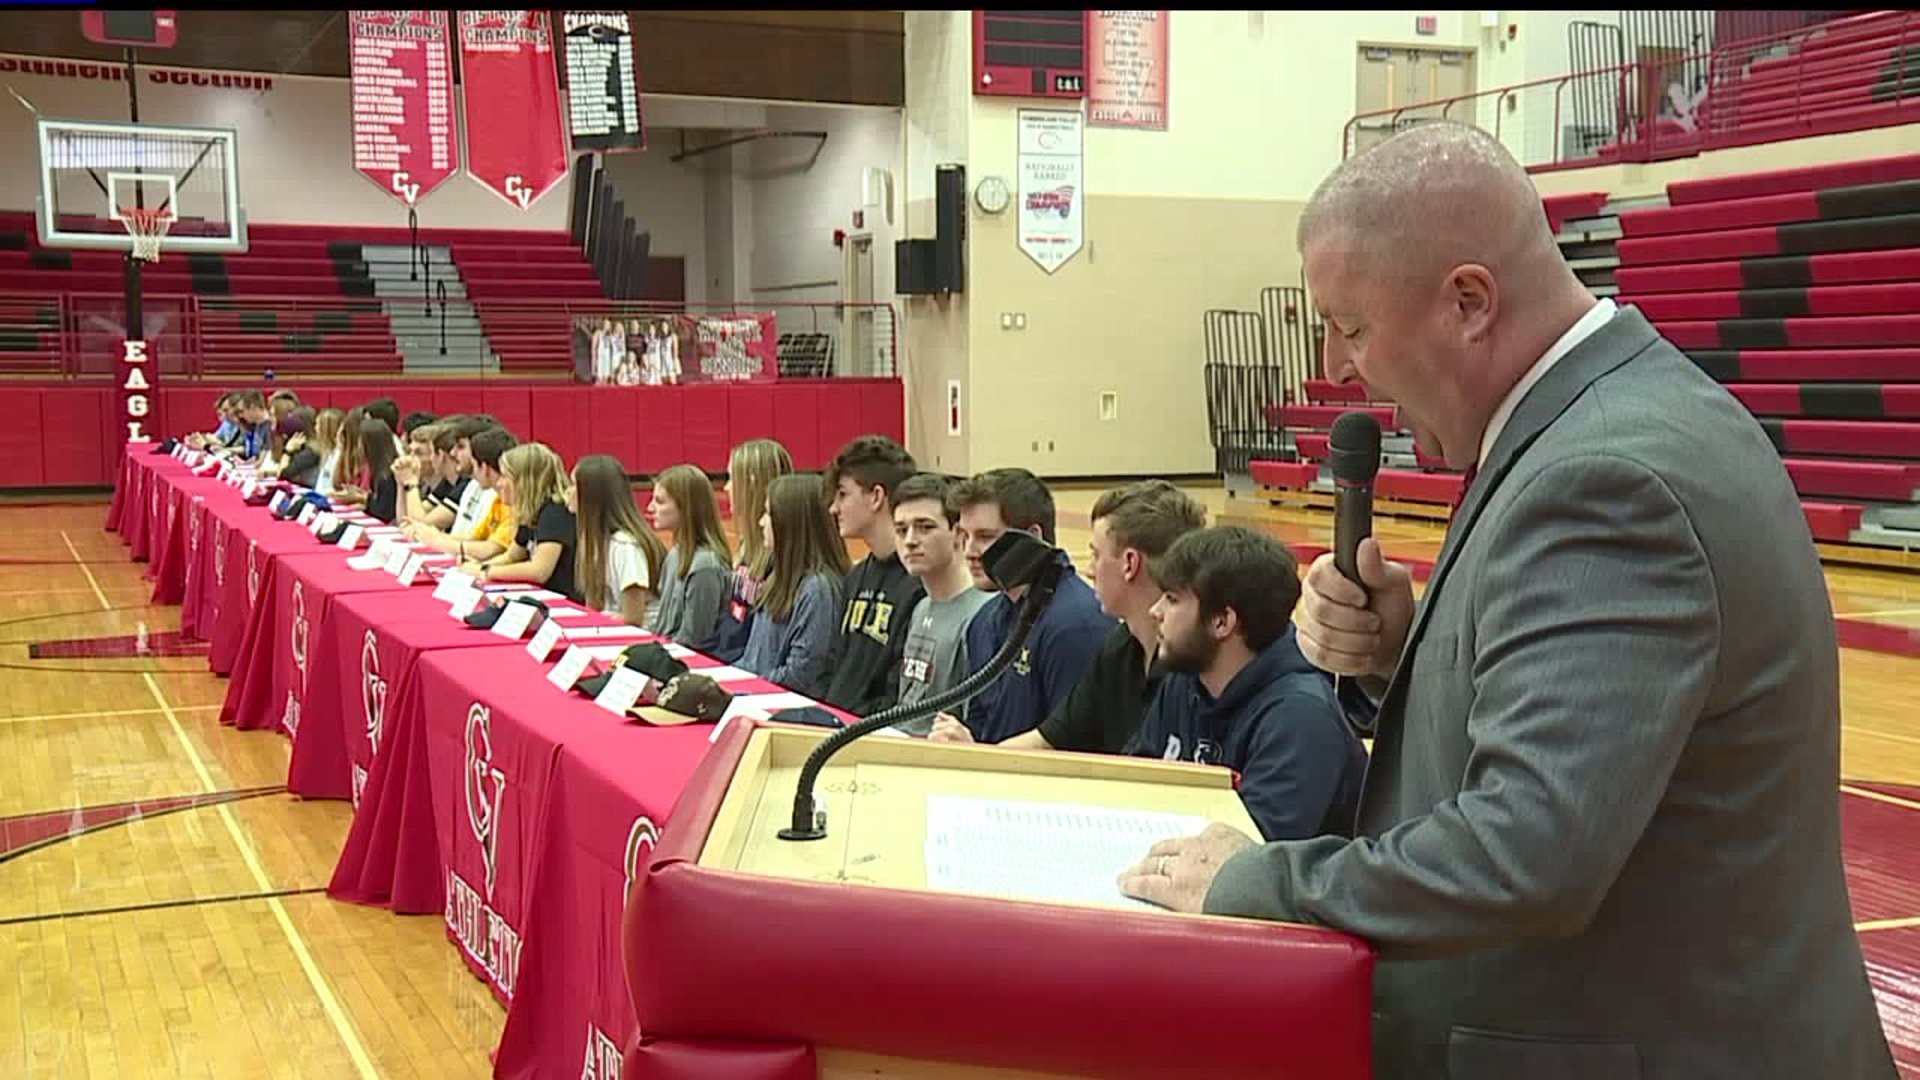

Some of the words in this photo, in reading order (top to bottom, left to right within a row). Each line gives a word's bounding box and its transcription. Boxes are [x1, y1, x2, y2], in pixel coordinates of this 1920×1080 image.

[356, 22, 443, 41] CHAMPIONS
[465, 26, 548, 43] CHAMPIONS
[564, 14, 629, 34] CHAMPIONS
[393, 172, 421, 204] CV
[505, 176, 533, 209] CV
[465, 702, 505, 902] CV
